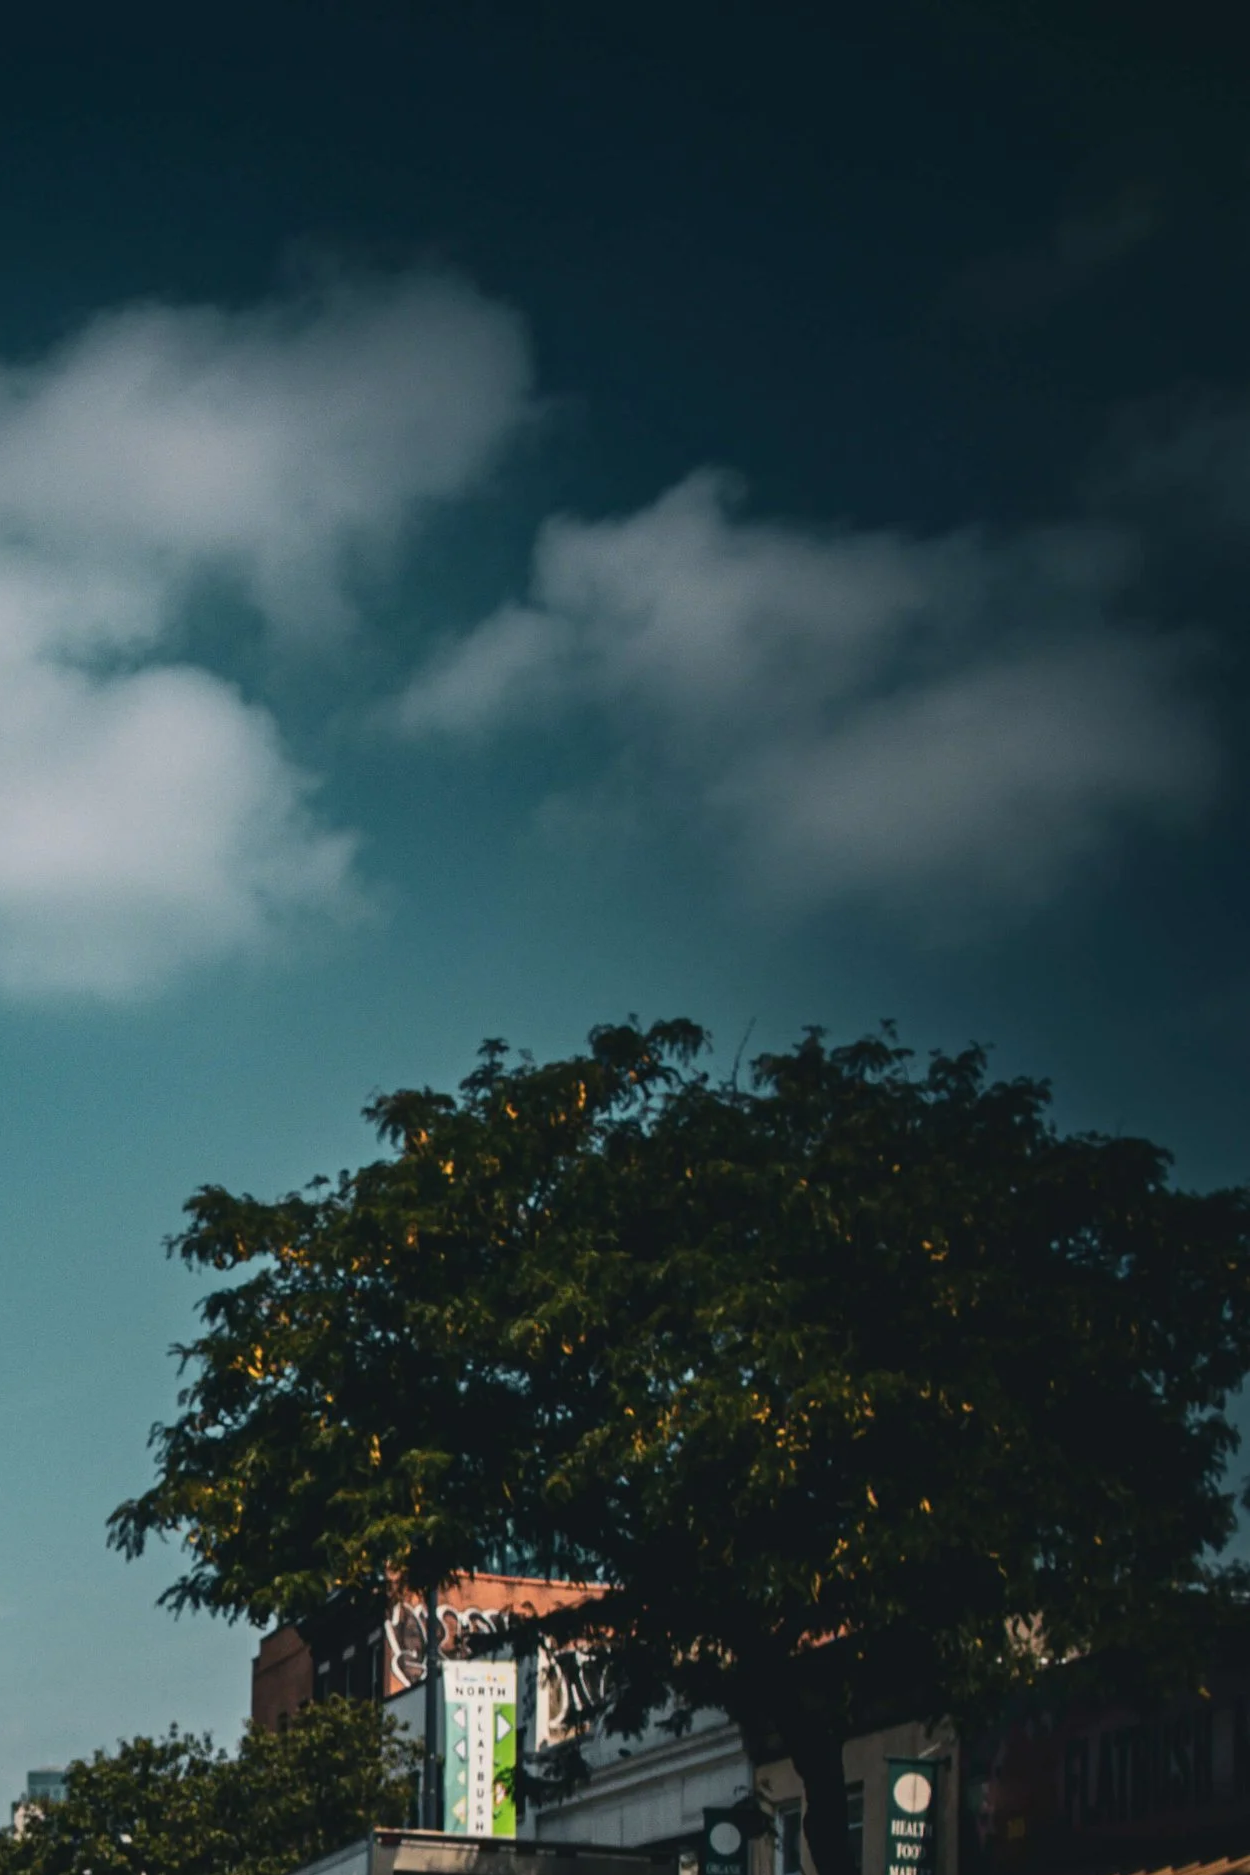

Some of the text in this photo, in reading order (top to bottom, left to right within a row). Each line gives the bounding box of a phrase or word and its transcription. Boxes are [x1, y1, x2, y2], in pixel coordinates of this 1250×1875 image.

[455, 1687, 506, 1697] NORTH
[476, 1705, 485, 1831] FLATBUSH
[891, 1820, 933, 1839] HEALTH
